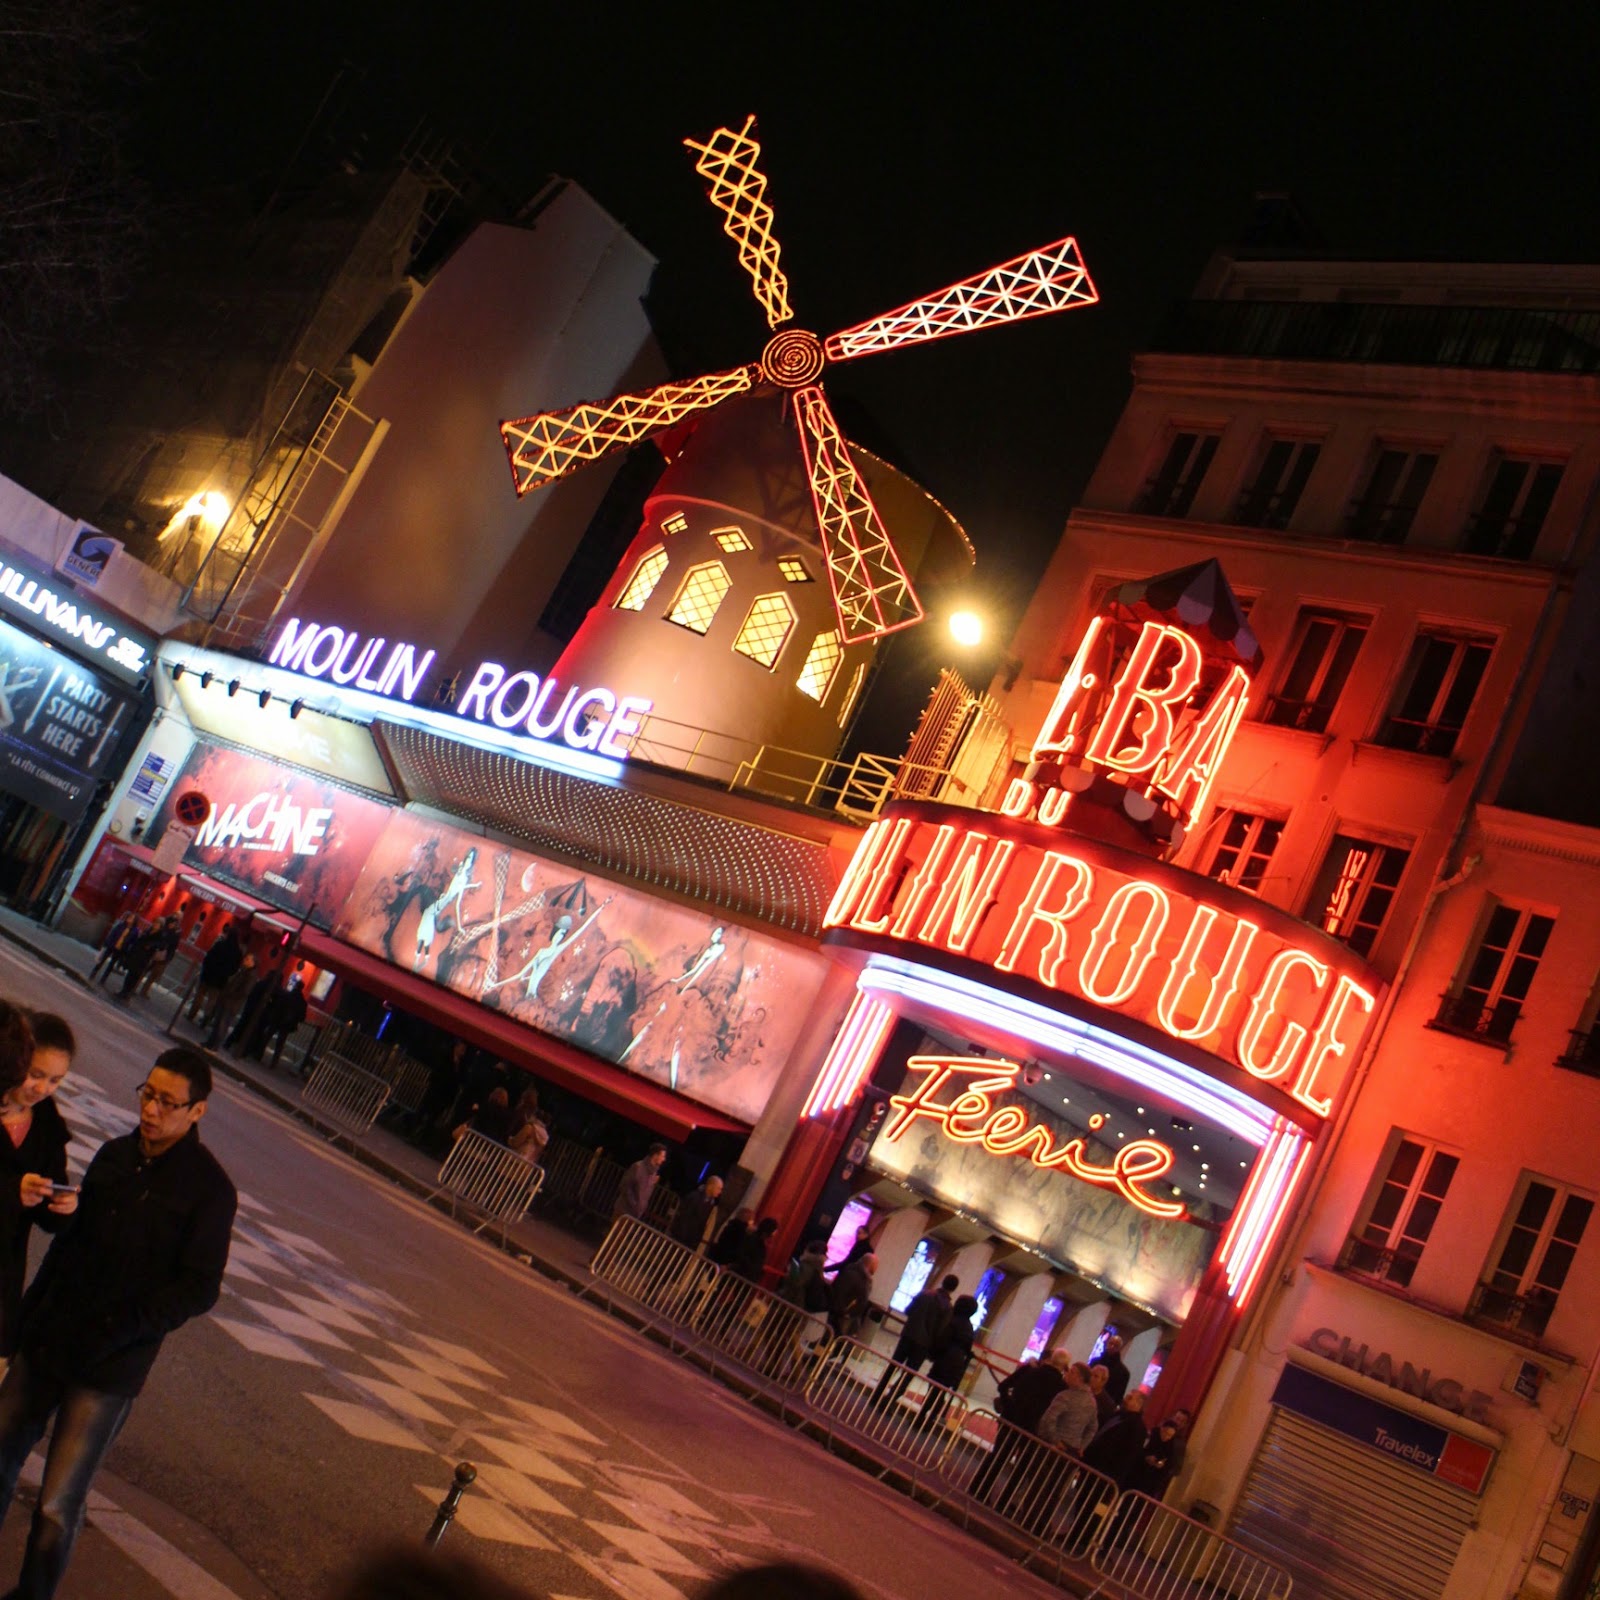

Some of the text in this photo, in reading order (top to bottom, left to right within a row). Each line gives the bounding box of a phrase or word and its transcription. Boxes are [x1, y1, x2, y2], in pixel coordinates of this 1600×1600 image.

[62, 673, 112, 712] PARTY
[269, 617, 654, 760] MOULIN ROUGE
[41, 723, 83, 758] HERE
[46, 696, 102, 738] STARTS
[11, 754, 20, 766] LA
[195, 792, 333, 856] MACHINE
[1001, 778, 1073, 826] DU
[994, 850, 1375, 1118] ROUGE
[883, 1056, 1186, 1217] Féerie
[1308, 1327, 1494, 1425] CHANGE
[1374, 1427, 1435, 1468] Travelex
